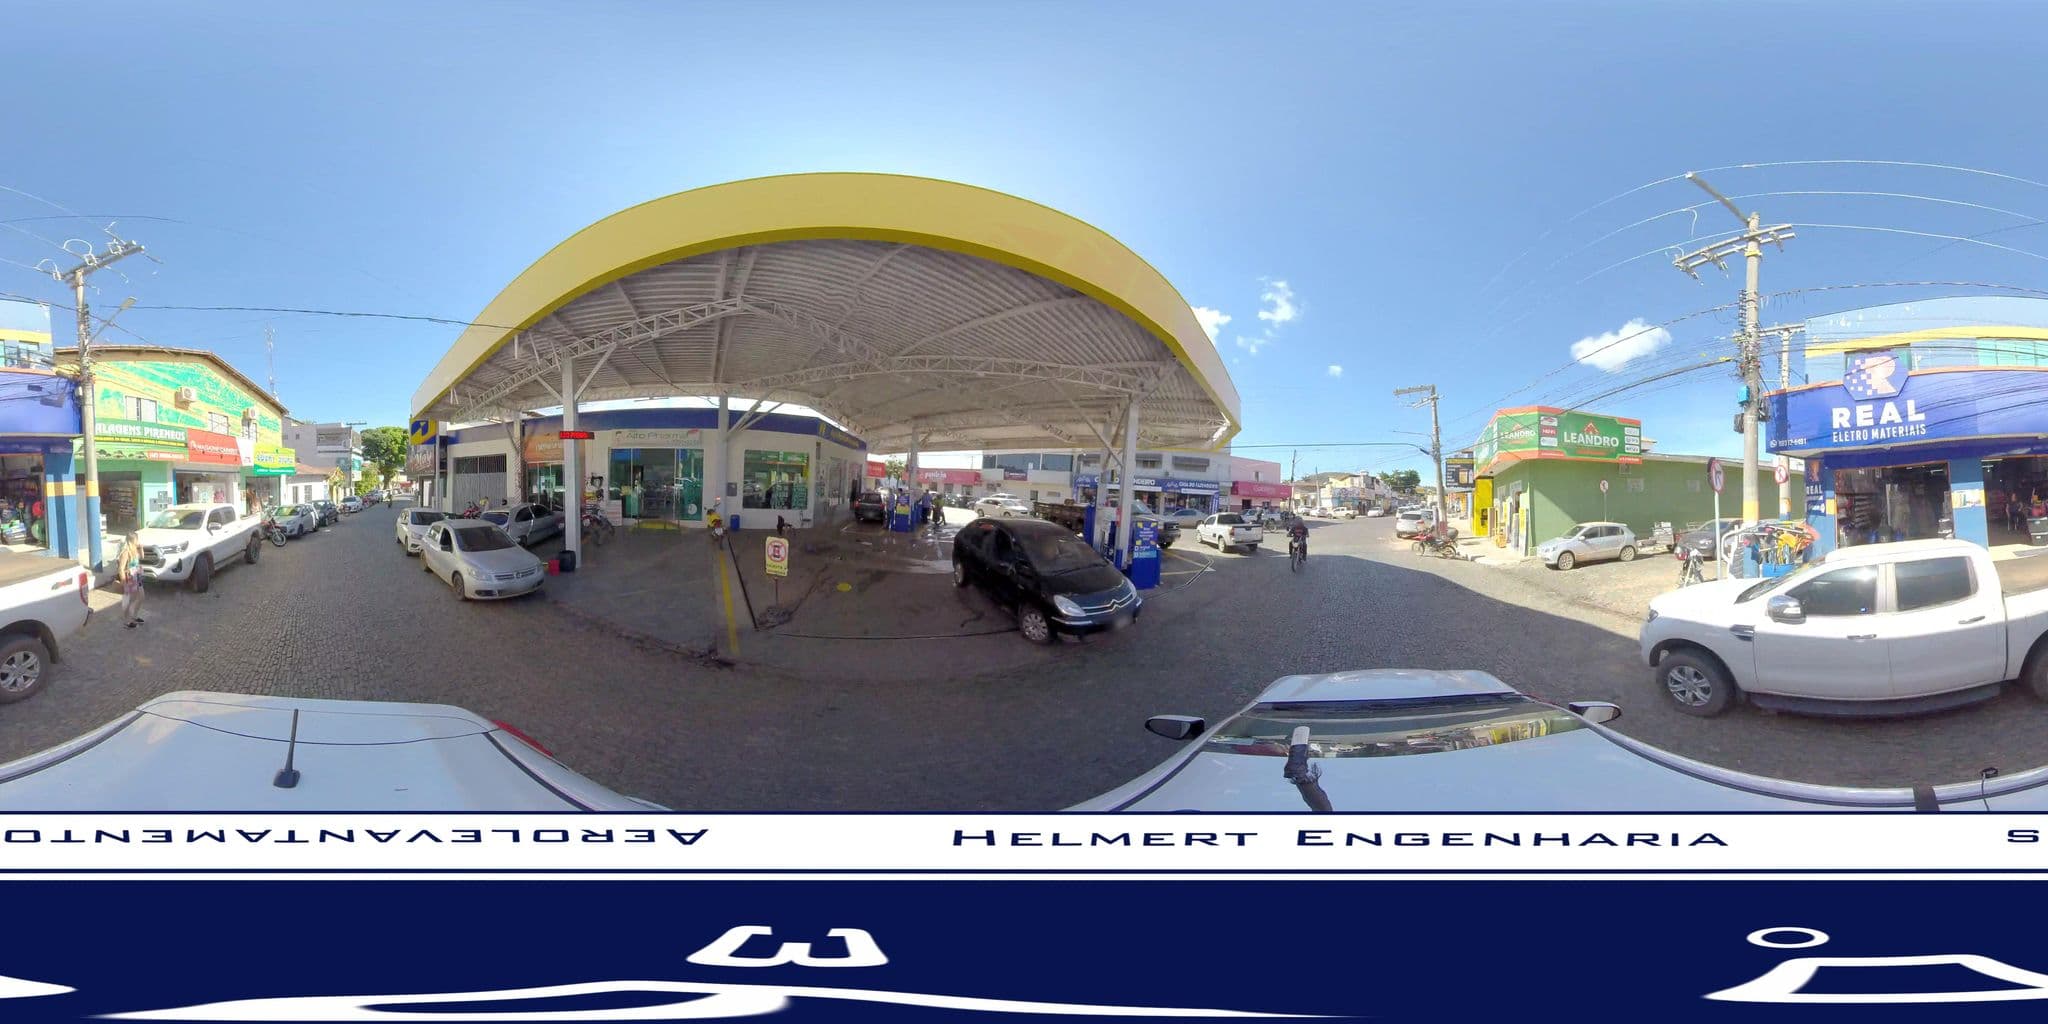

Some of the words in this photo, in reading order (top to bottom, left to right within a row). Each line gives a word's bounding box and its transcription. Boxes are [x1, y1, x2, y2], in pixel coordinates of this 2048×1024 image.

[1832, 399, 1926, 429] REAL
[94, 422, 142, 437] ALAGENS
[1832, 428, 1868, 443] ELETRO
[1871, 423, 1927, 440] MATERIAIS
[1563, 431, 1620, 447] LEANDRO
[1806, 484, 1823, 495] REAL
